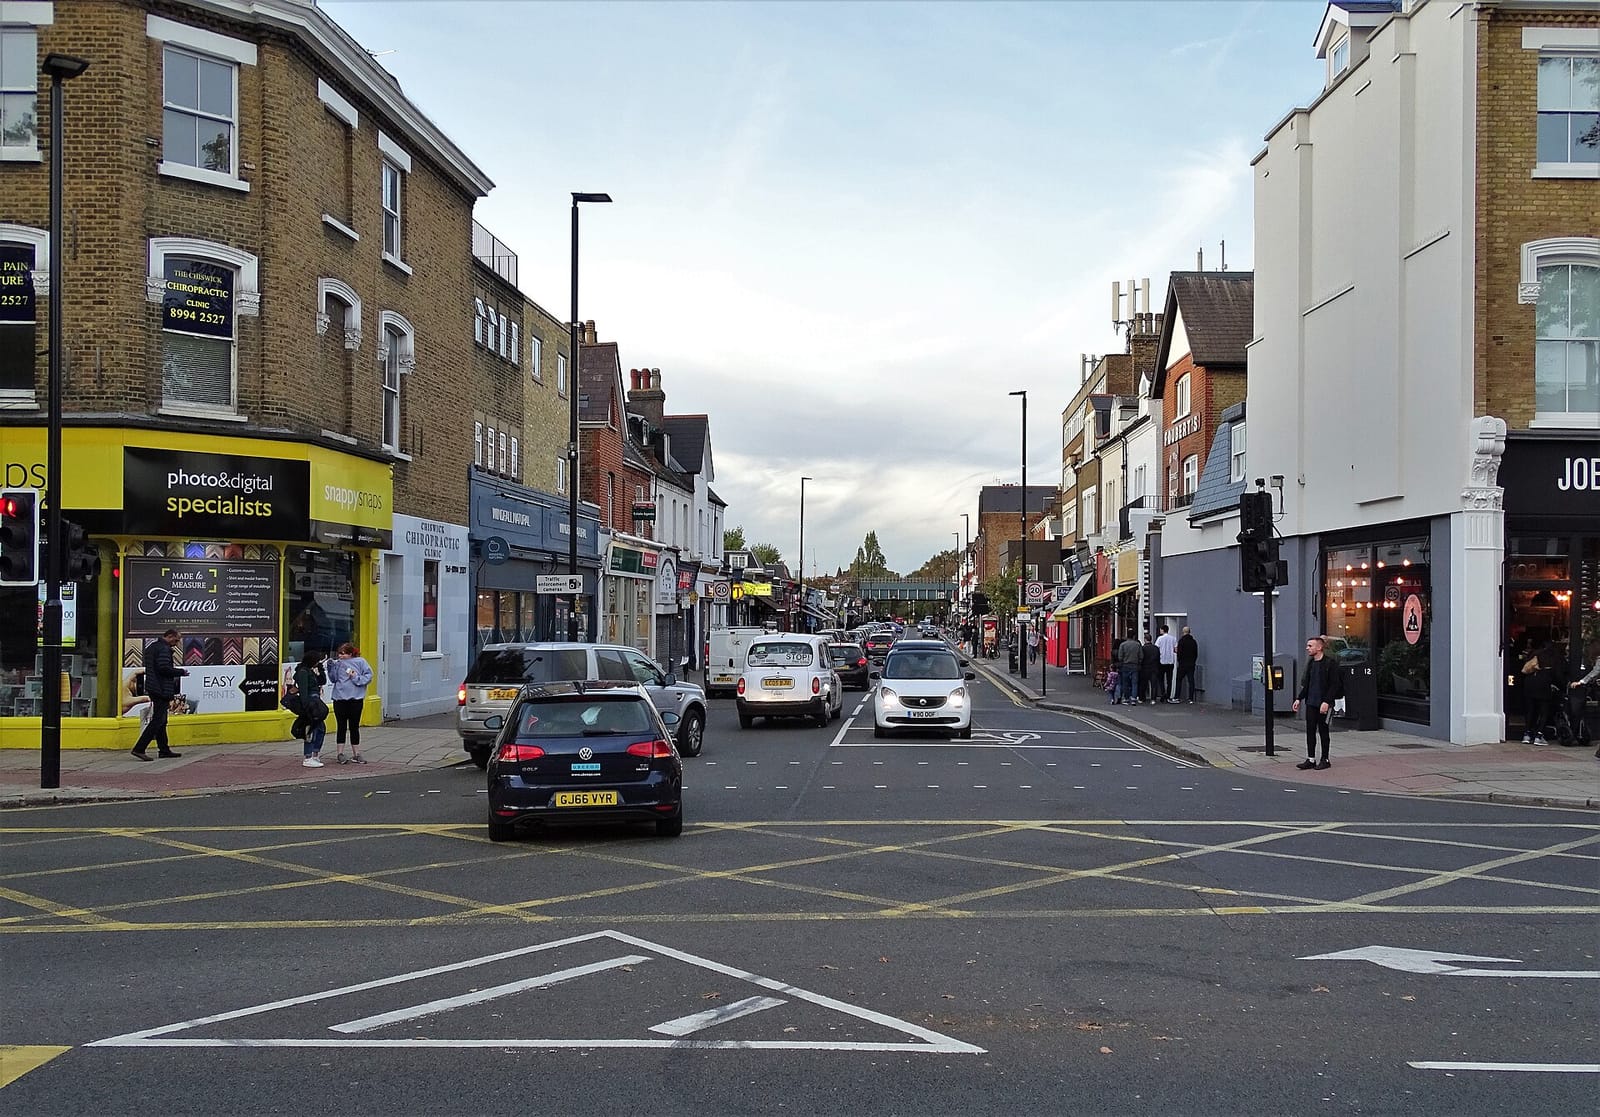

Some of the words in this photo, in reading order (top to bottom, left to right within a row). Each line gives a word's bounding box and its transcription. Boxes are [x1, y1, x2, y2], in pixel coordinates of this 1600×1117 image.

[3, 262, 28, 271] PAIN
[0, 276, 24, 285] URE
[175, 270, 188, 278] THE
[189, 272, 222, 284] CHISWICK
[167, 281, 229, 298] CHIROPRACTIC
[1, 295, 28, 305] 2527
[186, 299, 210, 309] CLINIC
[170, 307, 196, 320] 8994
[200, 312, 225, 325] 2527
[0, 463, 47, 489] ps
[168, 468, 273, 494] photo&digital
[325, 485, 383, 514] snappysnaps
[167, 495, 272, 518] specialists
[421, 522, 444, 534] CHISWICK
[405, 530, 460, 550] CHIROPRACTIC
[424, 548, 441, 558] CLINIC
[172, 572, 194, 580] MADE
[172, 581, 206, 589] MEASURE
[138, 587, 219, 615] Frames
[785, 653, 810, 661] STOP!
[203, 676, 235, 687] EASY
[203, 690, 235, 699] PRINTS
[560, 795, 588, 804] GJ66
[592, 793, 613, 803] VYR
